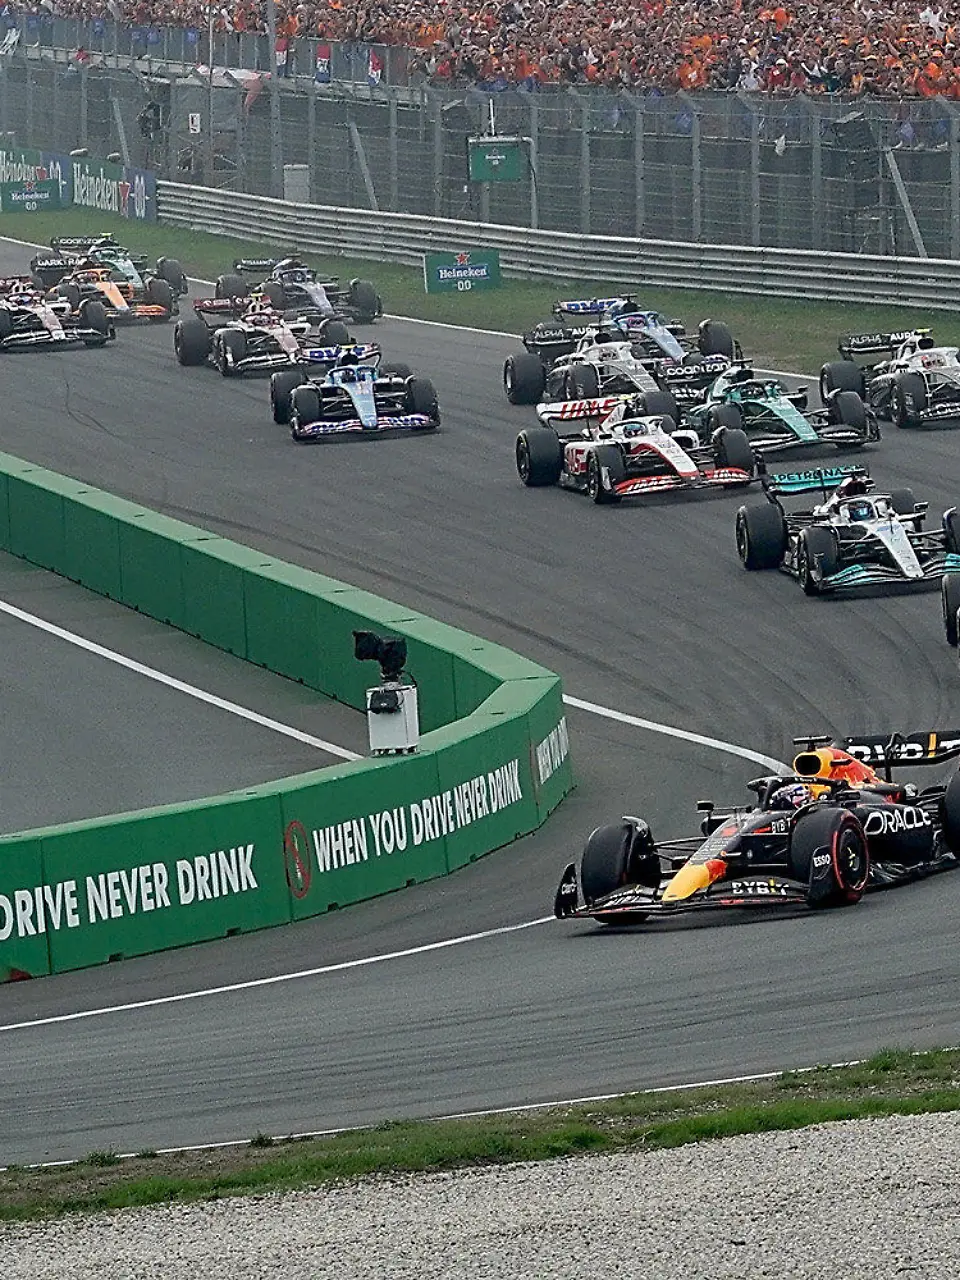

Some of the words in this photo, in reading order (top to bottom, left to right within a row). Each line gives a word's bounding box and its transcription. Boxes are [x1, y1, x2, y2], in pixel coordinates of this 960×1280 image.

[438, 266, 487, 279] Heineken
[312, 817, 369, 873] WHEN
[369, 806, 407, 858] YOU
[410, 790, 456, 846] DRIVE
[453, 775, 490, 829] NEVER
[488, 758, 523, 814] DRINK
[863, 805, 933, 836] ORACLE
[86, 862, 171, 924] NEVER
[176, 844, 258, 906] DRINK
